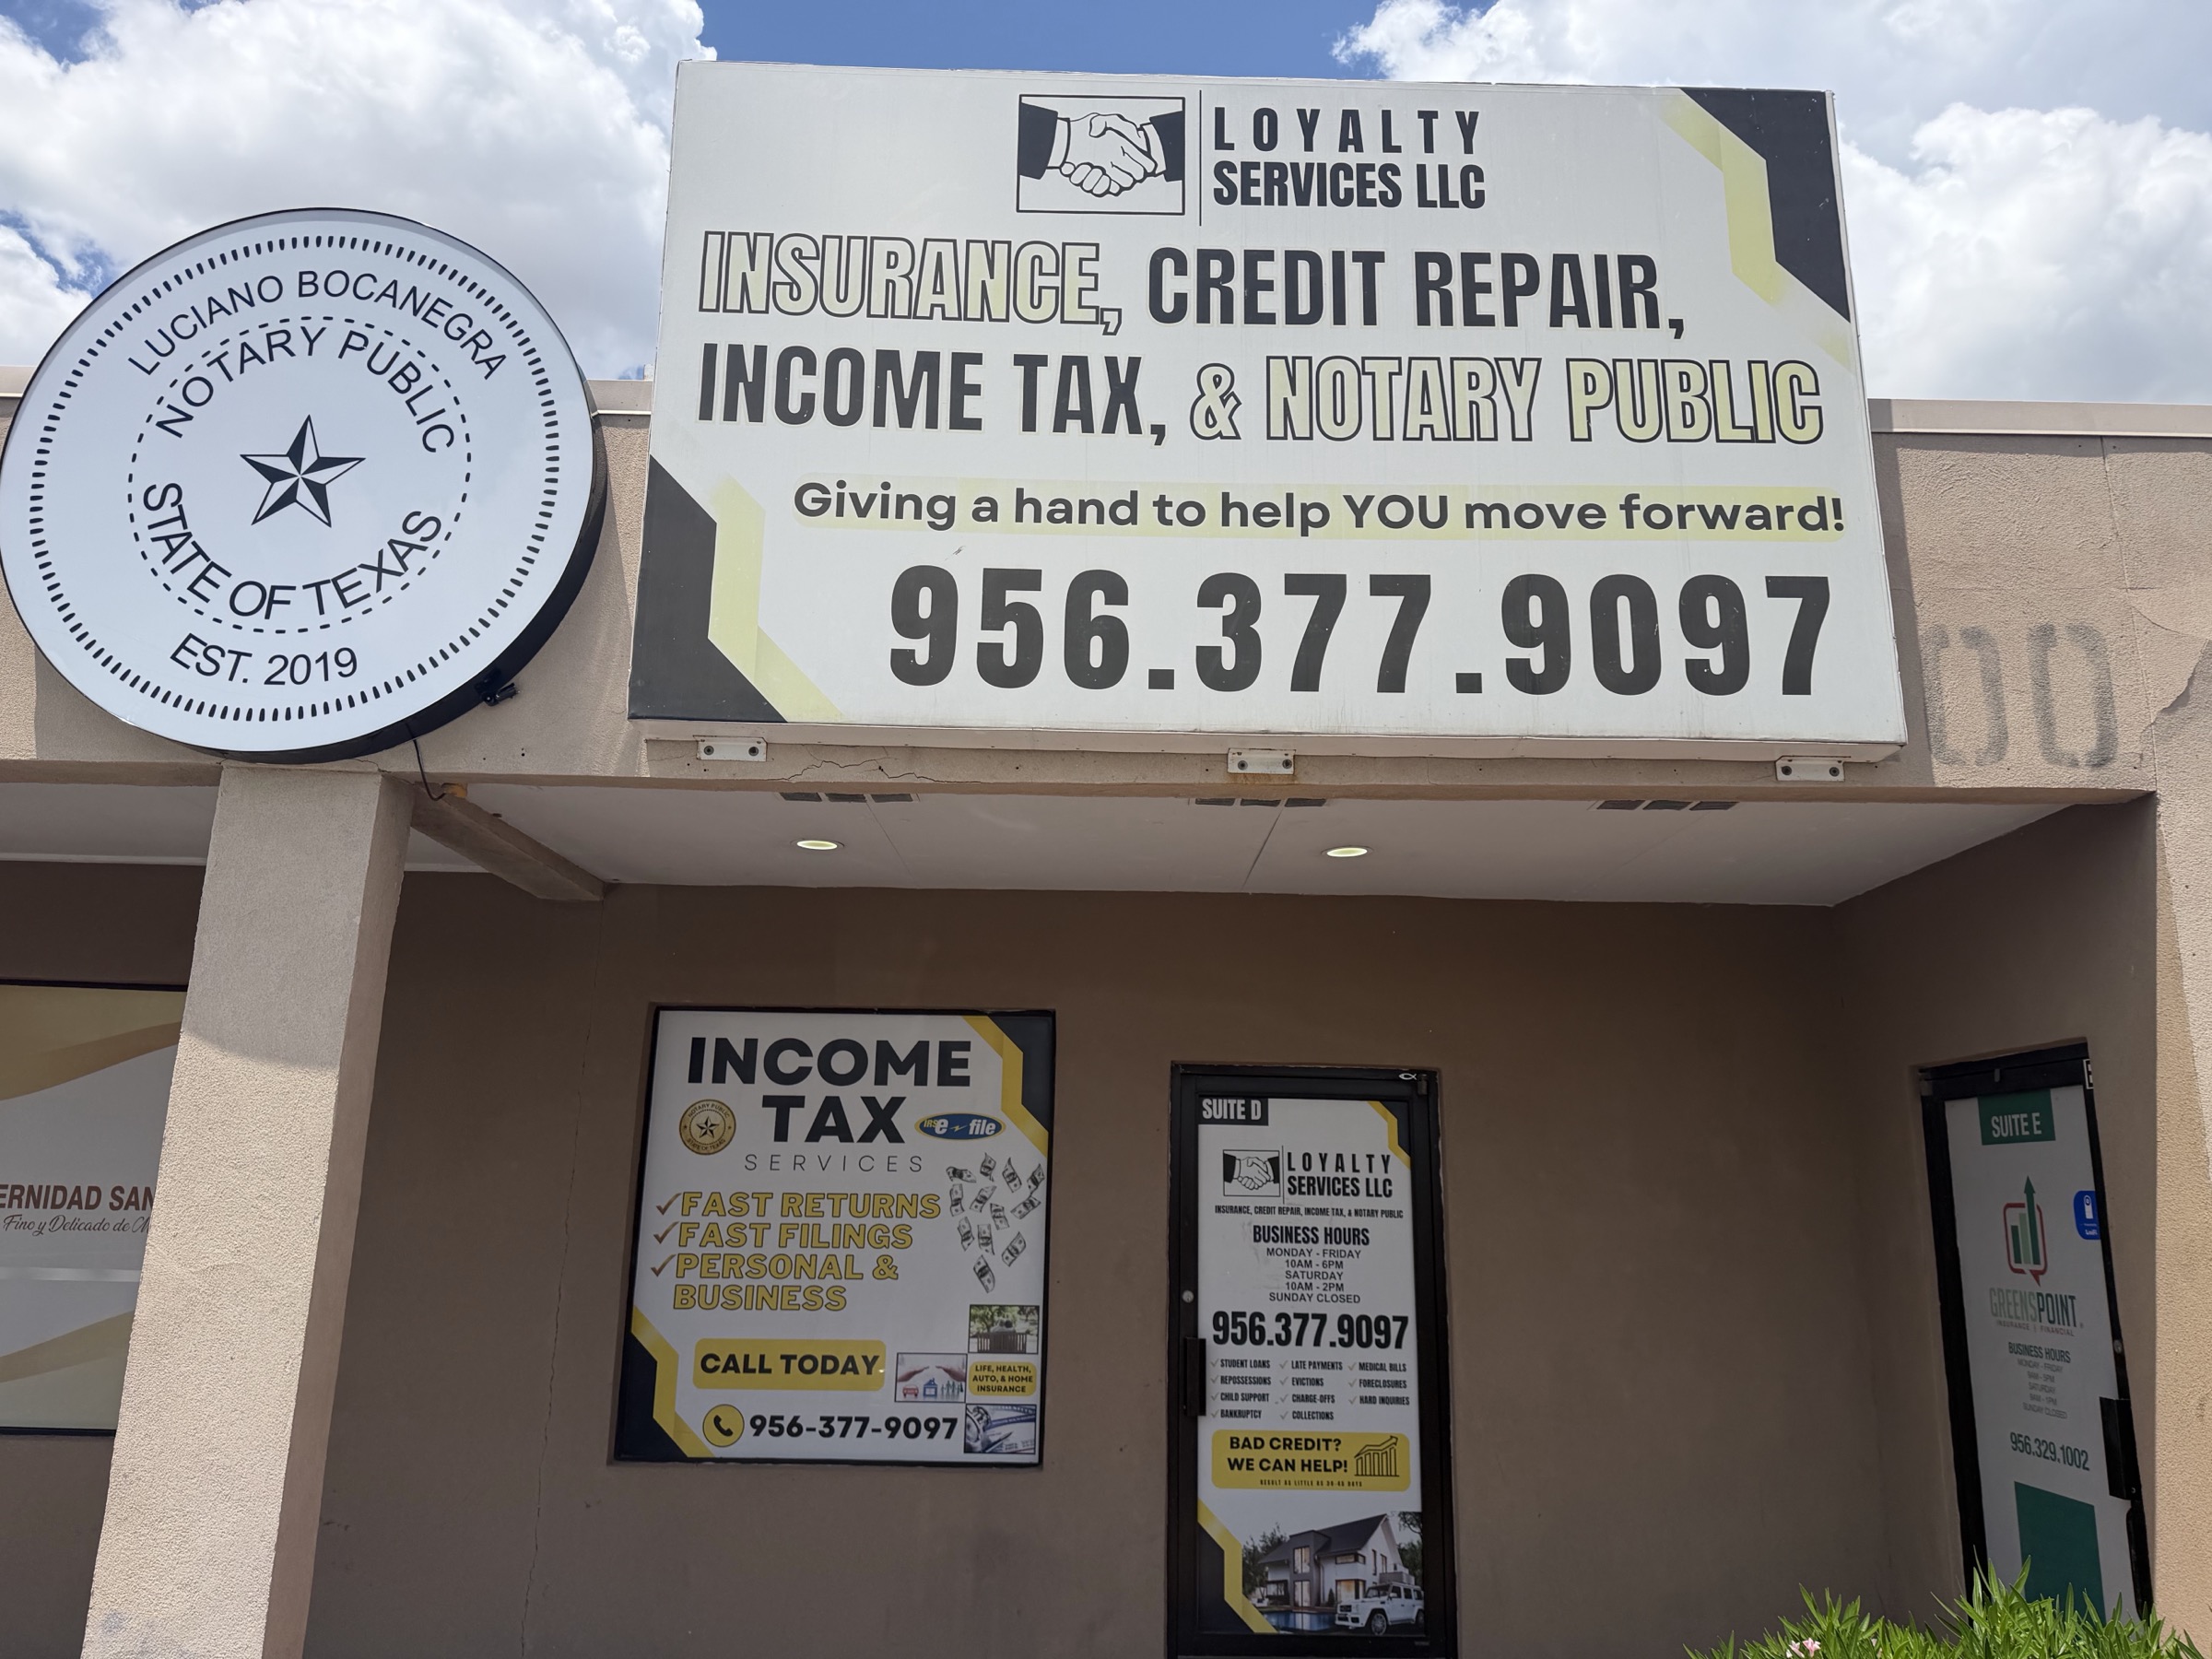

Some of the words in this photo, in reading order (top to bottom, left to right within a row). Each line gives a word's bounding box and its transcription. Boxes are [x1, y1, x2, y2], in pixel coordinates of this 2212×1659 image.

[1214, 106, 1480, 155] LOYALTY
[1213, 160, 1403, 208] SERVICES
[1416, 163, 1486, 209] LLC
[698, 230, 1123, 335] INSURANCE,
[1148, 247, 1385, 326] CREDIT
[1414, 251, 1685, 339] REPAIR,
[128, 275, 284, 376] LUCIANO
[297, 270, 507, 381] BOCANEGRA
[155, 326, 328, 439] NOTARY
[337, 330, 454, 453] PUBLIC
[698, 343, 983, 431] INCOME
[1014, 353, 1167, 446] TAX,
[1190, 362, 1241, 441] &
[1265, 355, 1542, 441] NOTARY
[1566, 358, 1824, 444] PUBLIC
[794, 479, 957, 531] Giving
[971, 496, 999, 524] a
[1014, 488, 1138, 525] hand
[1153, 494, 1206, 527] to
[1221, 491, 1330, 536] help
[1343, 494, 1448, 529] YOU
[1465, 500, 1606, 530] move
[1618, 493, 1845, 532] forward!
[143, 482, 232, 603] STATE
[229, 580, 296, 620] OF
[302, 511, 442, 616] TEXAS
[889, 565, 1830, 696] 956.377.9097
[171, 632, 251, 685] EST.
[265, 647, 358, 686] 2019
[688, 1037, 971, 1087] INCOME
[688, 1103, 710, 1118] NOTARY
[711, 1103, 730, 1118] PUBLIC
[761, 1095, 907, 1144] TAX
[1202, 1099, 1246, 1120] SUITE
[1251, 1100, 1262, 1120] D
[924, 1119, 937, 1128] IRS
[969, 1119, 995, 1135] file
[1992, 1113, 2030, 1137] SUITE
[2032, 1112, 2041, 1135] E
[687, 1138, 700, 1150] STATE
[710, 1139, 726, 1150] TEXAS
[744, 1154, 923, 1172] SERVICES
[1288, 1152, 1391, 1174] LOYALTY
[1288, 1176, 1360, 1197] SERVICES
[1366, 1178, 1393, 1198] LLC
[680, 1192, 773, 1217] FAST
[782, 1193, 941, 1219] RETURNS
[1215, 1206, 1253, 1216] INSURANCE,
[1254, 1206, 1276, 1215] CREDIT
[1278, 1206, 1303, 1217] REPAIR,
[1304, 1207, 1330, 1216] INCOME
[1331, 1207, 1346, 1217] TAX,
[1354, 1208, 1379, 1218] NOTARY
[1381, 1209, 1404, 1218] PUBLIC
[4, 1214, 34, 1231] Fino
[32, 1221, 47, 1236] y
[49, 1215, 110, 1233] Delicado
[113, 1218, 130, 1232] de
[1253, 1225, 1319, 1244] BUSINESS
[1324, 1227, 1370, 1245] HOURS
[678, 1222, 771, 1248] FAST
[779, 1223, 913, 1249] FILINGS
[1266, 1247, 1312, 1257] MONDAY
[1323, 1249, 1361, 1259] FRIDAY
[676, 1253, 864, 1280] PERSONAL
[873, 1255, 899, 1280] &
[1285, 1259, 1312, 1268] 10AM
[1322, 1260, 1344, 1269] 6PM
[1285, 1270, 1344, 1280] SATURDAY
[1285, 1281, 1312, 1291] 10AM
[1322, 1282, 1345, 1291] 2PM
[673, 1285, 847, 1312] BUSINESS
[1269, 1292, 1313, 1302] SUNDAY
[1316, 1293, 1360, 1303] CLOSED
[1212, 1311, 1409, 1349] 956.377.9097
[1996, 1320, 2030, 1330] INSURANCE
[2041, 1325, 2076, 1336] FINANCIAL
[2008, 1342, 2043, 1359] BUSINESS
[2044, 1347, 2071, 1363] HOURS
[700, 1353, 772, 1375] CALL
[781, 1354, 879, 1376] TODAY
[996, 1365, 1031, 1373] HEALTH,
[1220, 1359, 1248, 1368] STUDENT
[1250, 1359, 1270, 1369] LOANS
[1291, 1360, 1306, 1370] LATE
[1309, 1360, 1343, 1371] PAYMENTS
[1359, 1362, 1387, 1371] MEDICAL
[1389, 1363, 1406, 1371] BILLS
[1220, 1375, 1271, 1385] REPOSSESSIONS
[1291, 1377, 1324, 1386] EVICTIONS
[1359, 1379, 1406, 1388] FORECLOSURES
[1220, 1393, 1239, 1401] CHILD
[1241, 1393, 1269, 1402] SUPPORT
[1292, 1394, 1335, 1404] CHARGE-OFFS
[1359, 1395, 1377, 1405] HARD
[1379, 1396, 1410, 1406] INQUIRIES
[1220, 1409, 1262, 1418] BANKRUPTCY
[1292, 1410, 1334, 1420] COLLECTIONS
[749, 1414, 958, 1440] 956-377-9097
[1230, 1436, 1265, 1449] BAD
[1269, 1437, 1341, 1451] CREDIT?
[2010, 1431, 2089, 1471] 956.329.1002
[1227, 1458, 1254, 1471] WE
[1259, 1458, 1295, 1472] CAN
[1301, 1459, 1347, 1473] HELP!
